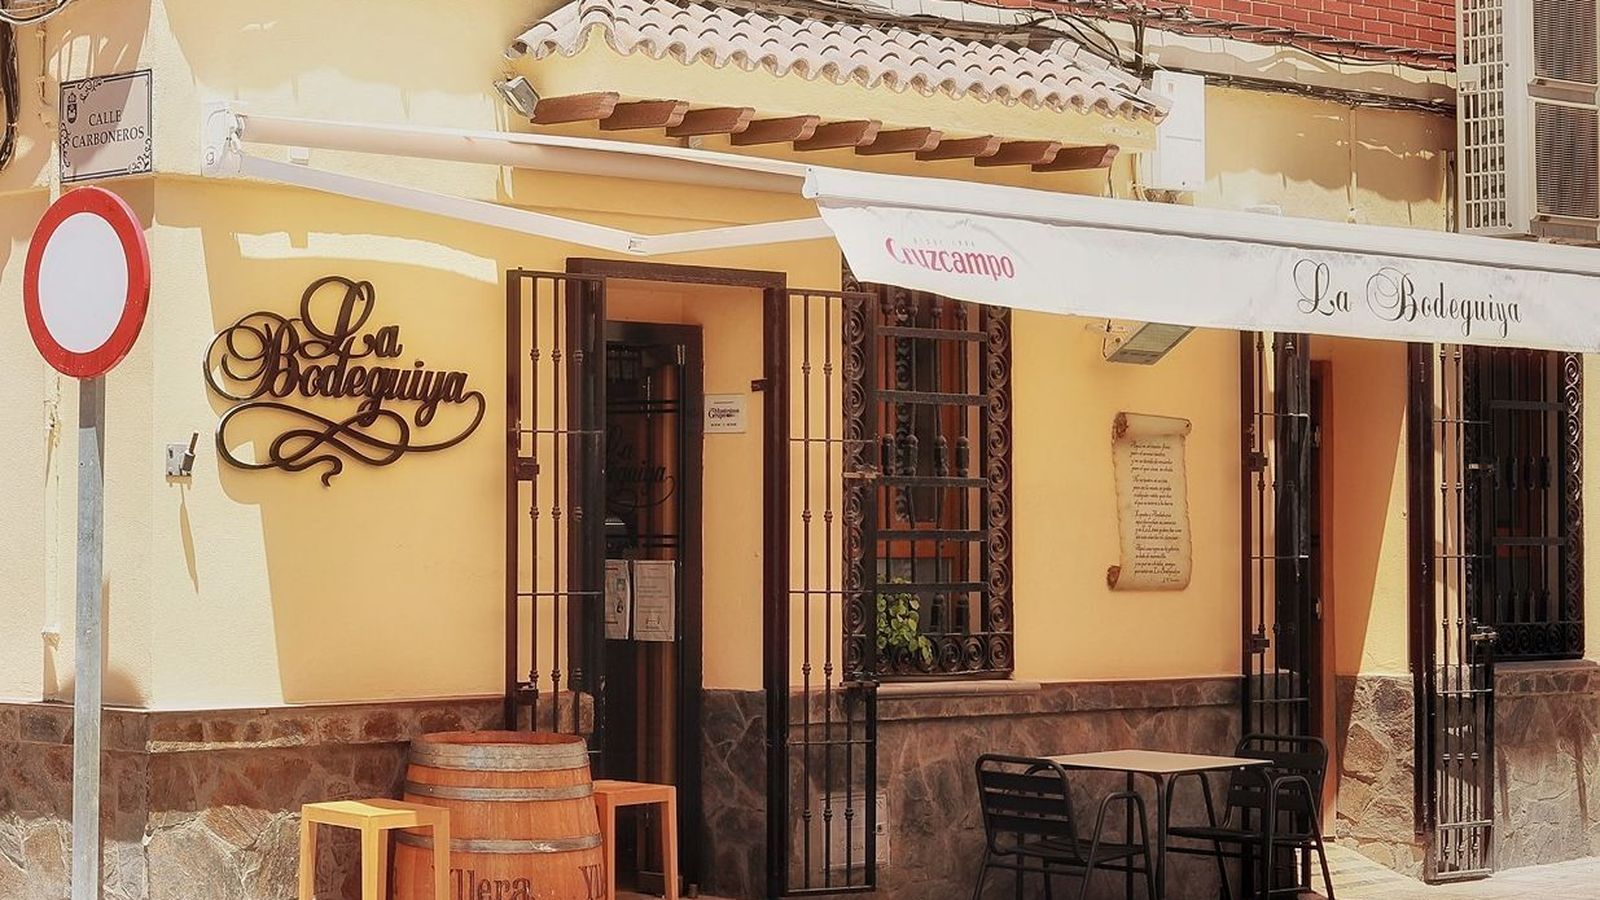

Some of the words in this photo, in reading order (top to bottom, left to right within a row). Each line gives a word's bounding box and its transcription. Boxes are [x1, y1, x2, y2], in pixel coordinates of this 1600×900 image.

[71, 126, 145, 149] CARBONEROS
[88, 109, 123, 127] CALLE
[885, 237, 1014, 281] Cruzcampo
[299, 275, 404, 359] La
[1293, 258, 1350, 316] La
[1366, 266, 1522, 338] Bodeguiya
[202, 310, 478, 452] Bodeguiya
[438, 868, 534, 900] llera
